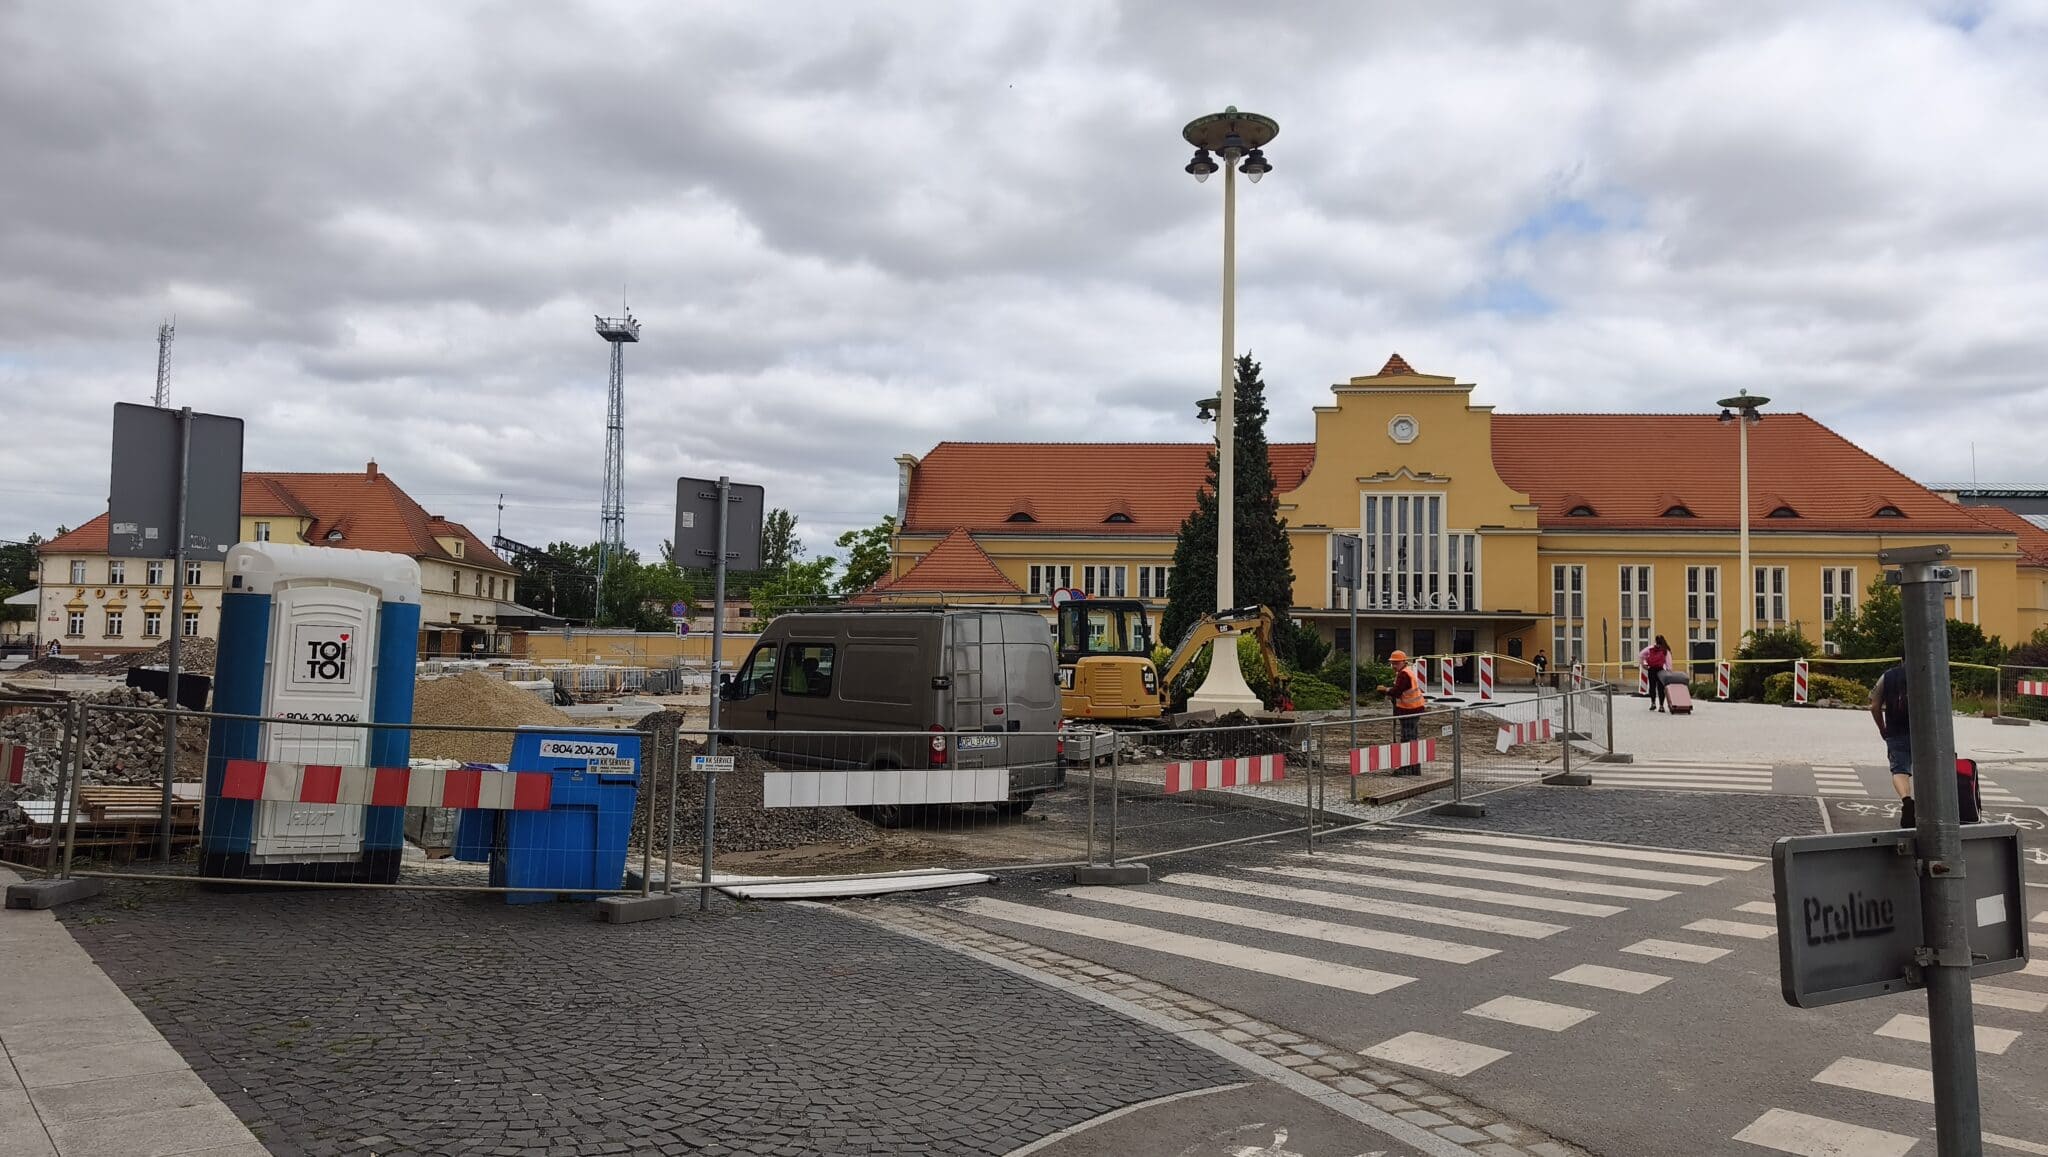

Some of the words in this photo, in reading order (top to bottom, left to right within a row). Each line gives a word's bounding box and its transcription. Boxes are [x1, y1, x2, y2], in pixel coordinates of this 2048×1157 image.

[75, 587, 195, 600] POCZTA
[1367, 591, 1459, 607] LEGNCA
[306, 660, 346, 680] TOI
[552, 743, 573, 754] 804
[574, 744, 595, 755] 204
[596, 746, 616, 756] 204
